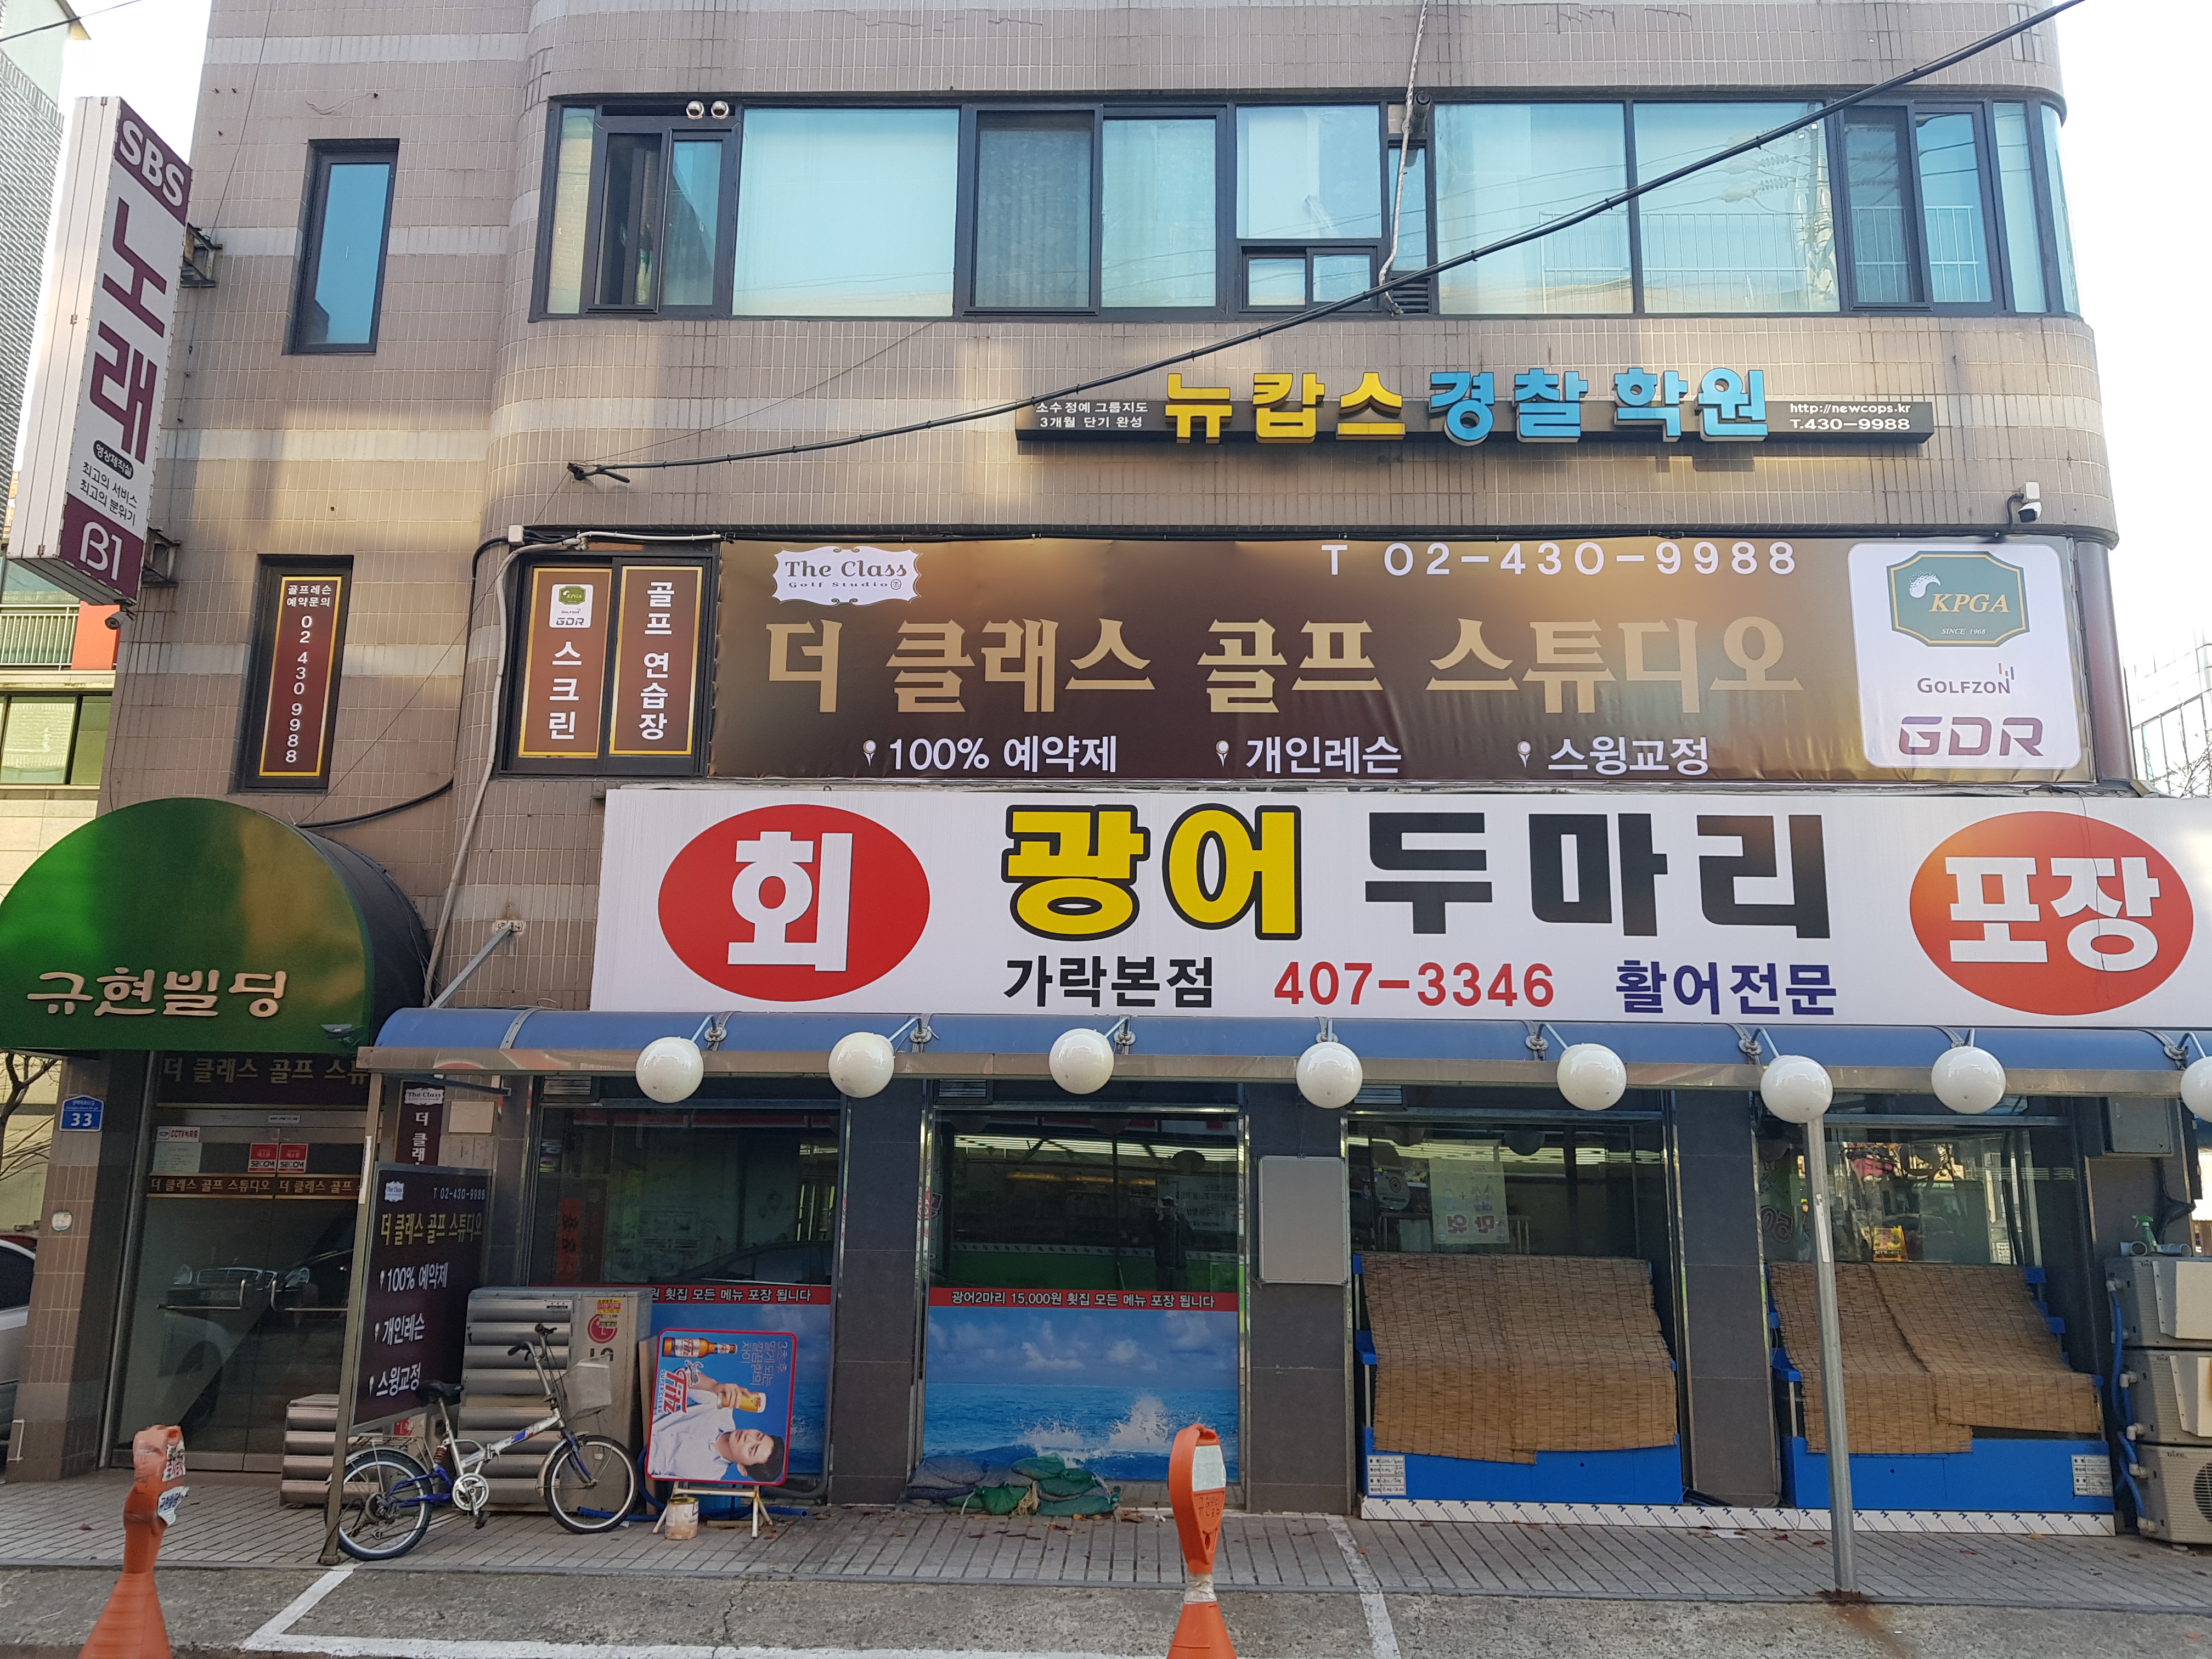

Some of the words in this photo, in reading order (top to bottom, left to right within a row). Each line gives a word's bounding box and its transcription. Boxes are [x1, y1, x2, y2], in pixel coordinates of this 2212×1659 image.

[118, 119, 185, 206] SBS
[89, 196, 167, 466] 노래
[1040, 416, 1075, 428] 3개월
[1084, 416, 1109, 428] 단기
[1116, 416, 1142, 428] 완성
[1094, 402, 1148, 413] 그룹지도
[1790, 403, 1911, 414] http://newcops.kr
[1790, 418, 1910, 430] T.430-9988
[96, 444, 132, 477] 영상제작실
[82, 461, 109, 490] 최고의
[112, 483, 137, 509] 서비스
[80, 479, 107, 507] 최고의
[110, 499, 136, 526] 분위기
[80, 521, 122, 582] B1
[1321, 543, 1348, 576] T
[1383, 542, 1797, 577] 02-430-9988
[785, 560, 832, 577] The
[841, 560, 907, 577] Class
[286, 597, 330, 607] 예약문의
[287, 585, 331, 595] 골프레슨
[1929, 593, 2009, 613] KPGA
[644, 581, 676, 636] 골프
[766, 618, 843, 712] 더
[886, 618, 1155, 712] 클래스
[1197, 618, 1384, 712] 골프
[1426, 618, 1804, 713] 스튜디오
[549, 640, 582, 741] 스크린
[639, 651, 669, 741] 연습장
[1899, 716, 2044, 756] GDR
[889, 737, 990, 771] 100%
[1003, 736, 1117, 773] 예약제
[1246, 736, 1402, 775] 개인레슨
[1548, 736, 1709, 775] 스윙교정
[1002, 803, 1302, 942] 광어
[1364, 811, 1831, 939] 두마리
[727, 830, 854, 973] 회
[1944, 856, 2160, 973] 포장
[27, 967, 287, 1018] 규현빌딩
[1003, 955, 1214, 1008] 가락본점
[1274, 962, 1555, 1008] 407-3346
[1615, 960, 1837, 1017] 활어전문
[165, 1058, 183, 1082] 더
[193, 1058, 258, 1084] 클래스
[269, 1059, 314, 1084] 골프
[71, 1113, 92, 1127] 33
[415, 1112, 429, 1126] 더
[411, 1132, 427, 1165] 클래
[151, 1179, 160, 1191] 더
[165, 1179, 196, 1192] 클래스
[201, 1180, 223, 1192] 골프
[228, 1180, 270, 1193] 스튜디오
[280, 1180, 289, 1193] 더
[294, 1181, 325, 1193] 클래스
[330, 1181, 352, 1193] 골프
[440, 1188, 486, 1200] 02-430-9988
[381, 1213, 391, 1246] 더
[394, 1213, 423, 1245] 클래스
[427, 1214, 445, 1244] 골프
[448, 1213, 482, 1242] 스튜디오
[387, 1266, 415, 1293] 100%
[418, 1262, 448, 1290] 예약제
[665, 1288, 688, 1301] 횟집
[692, 1289, 715, 1300] 모든
[720, 1289, 743, 1301] 메뉴
[748, 1289, 772, 1301] 포장
[776, 1289, 811, 1302] 됩니다
[951, 1291, 1006, 1305] 광어2마리
[1011, 1291, 1062, 1306] 15,000원
[1067, 1293, 1091, 1306] 횟집
[1096, 1293, 1118, 1306] 모든
[1122, 1294, 1147, 1307] 메뉴
[1150, 1294, 1175, 1308] 포장
[1180, 1295, 1215, 1308] 됩니다
[382, 1313, 425, 1345] 개인레슨
[683, 1339, 694, 1357] Fitz
[376, 1362, 421, 1397] 스윙교정
[664, 1369, 687, 1414] Fitz
